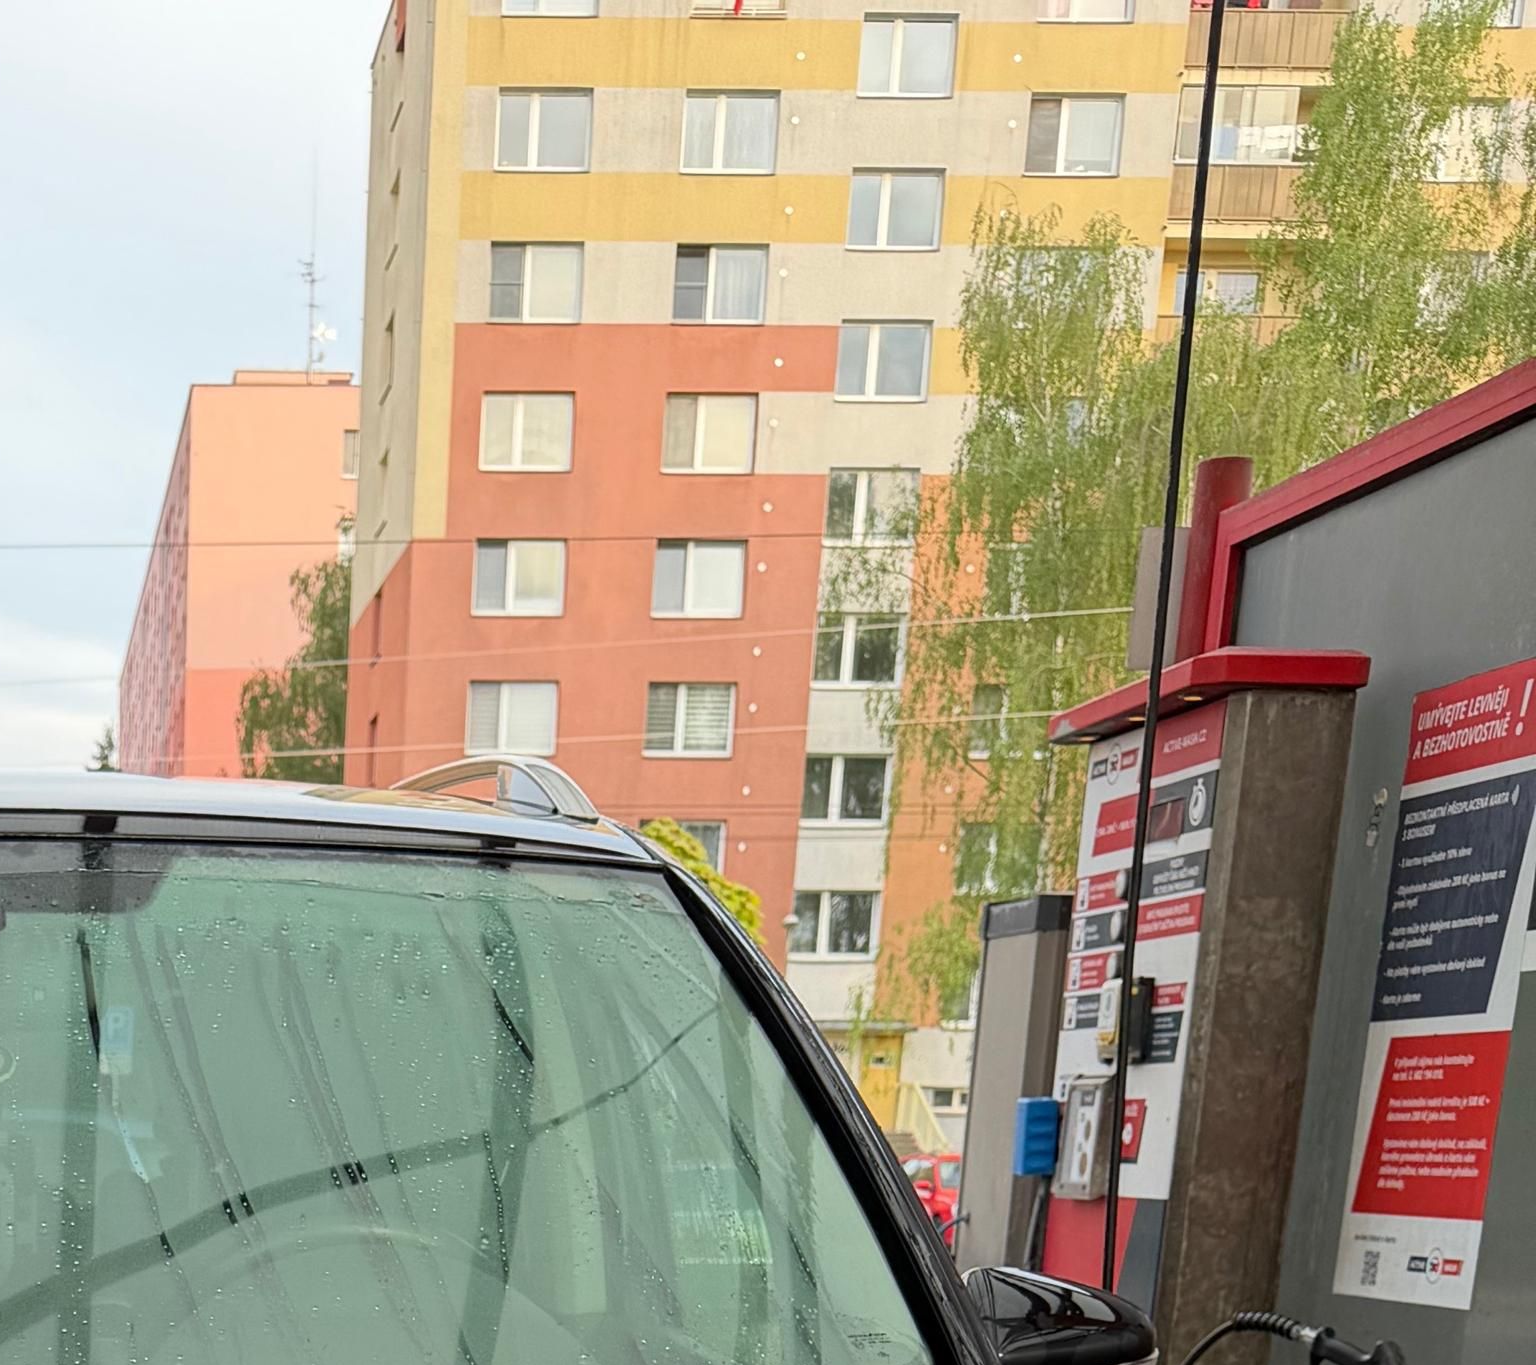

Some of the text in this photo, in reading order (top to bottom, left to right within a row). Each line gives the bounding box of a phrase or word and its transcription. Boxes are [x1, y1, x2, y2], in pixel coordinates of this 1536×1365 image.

[1417, 684, 1510, 731] UMÝVEJTE LEVNĚJI
[1412, 711, 1511, 760] A BEZHOTOVOSTNĚ
